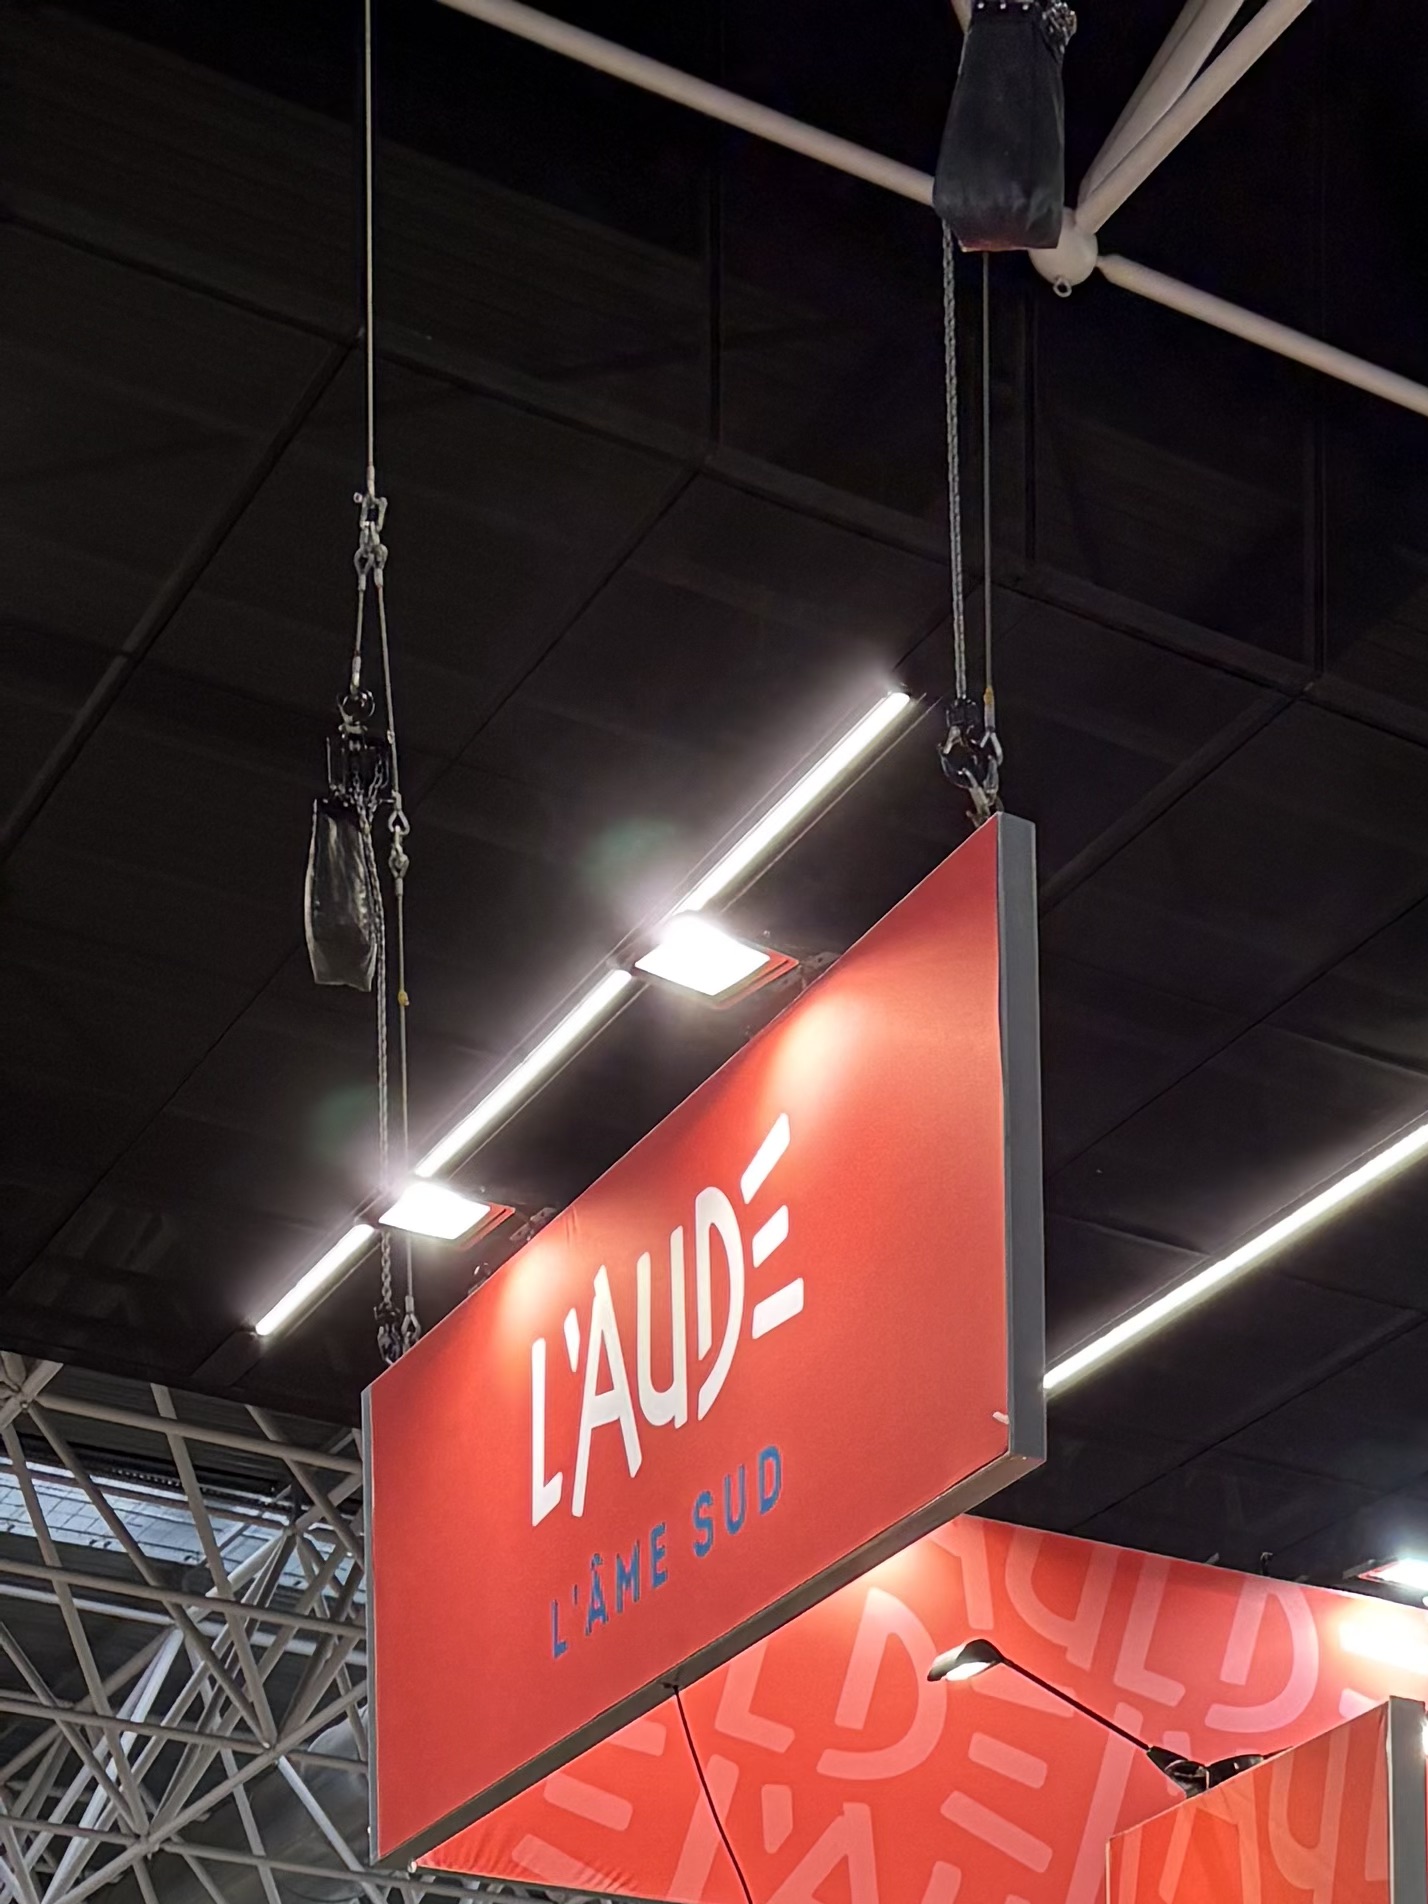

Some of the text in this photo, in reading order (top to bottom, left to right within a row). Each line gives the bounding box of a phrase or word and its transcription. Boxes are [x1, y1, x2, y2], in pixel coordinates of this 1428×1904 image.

[531, 1112, 805, 1527] L'AUDE
[550, 1445, 785, 1660] L'ÂME SUD
